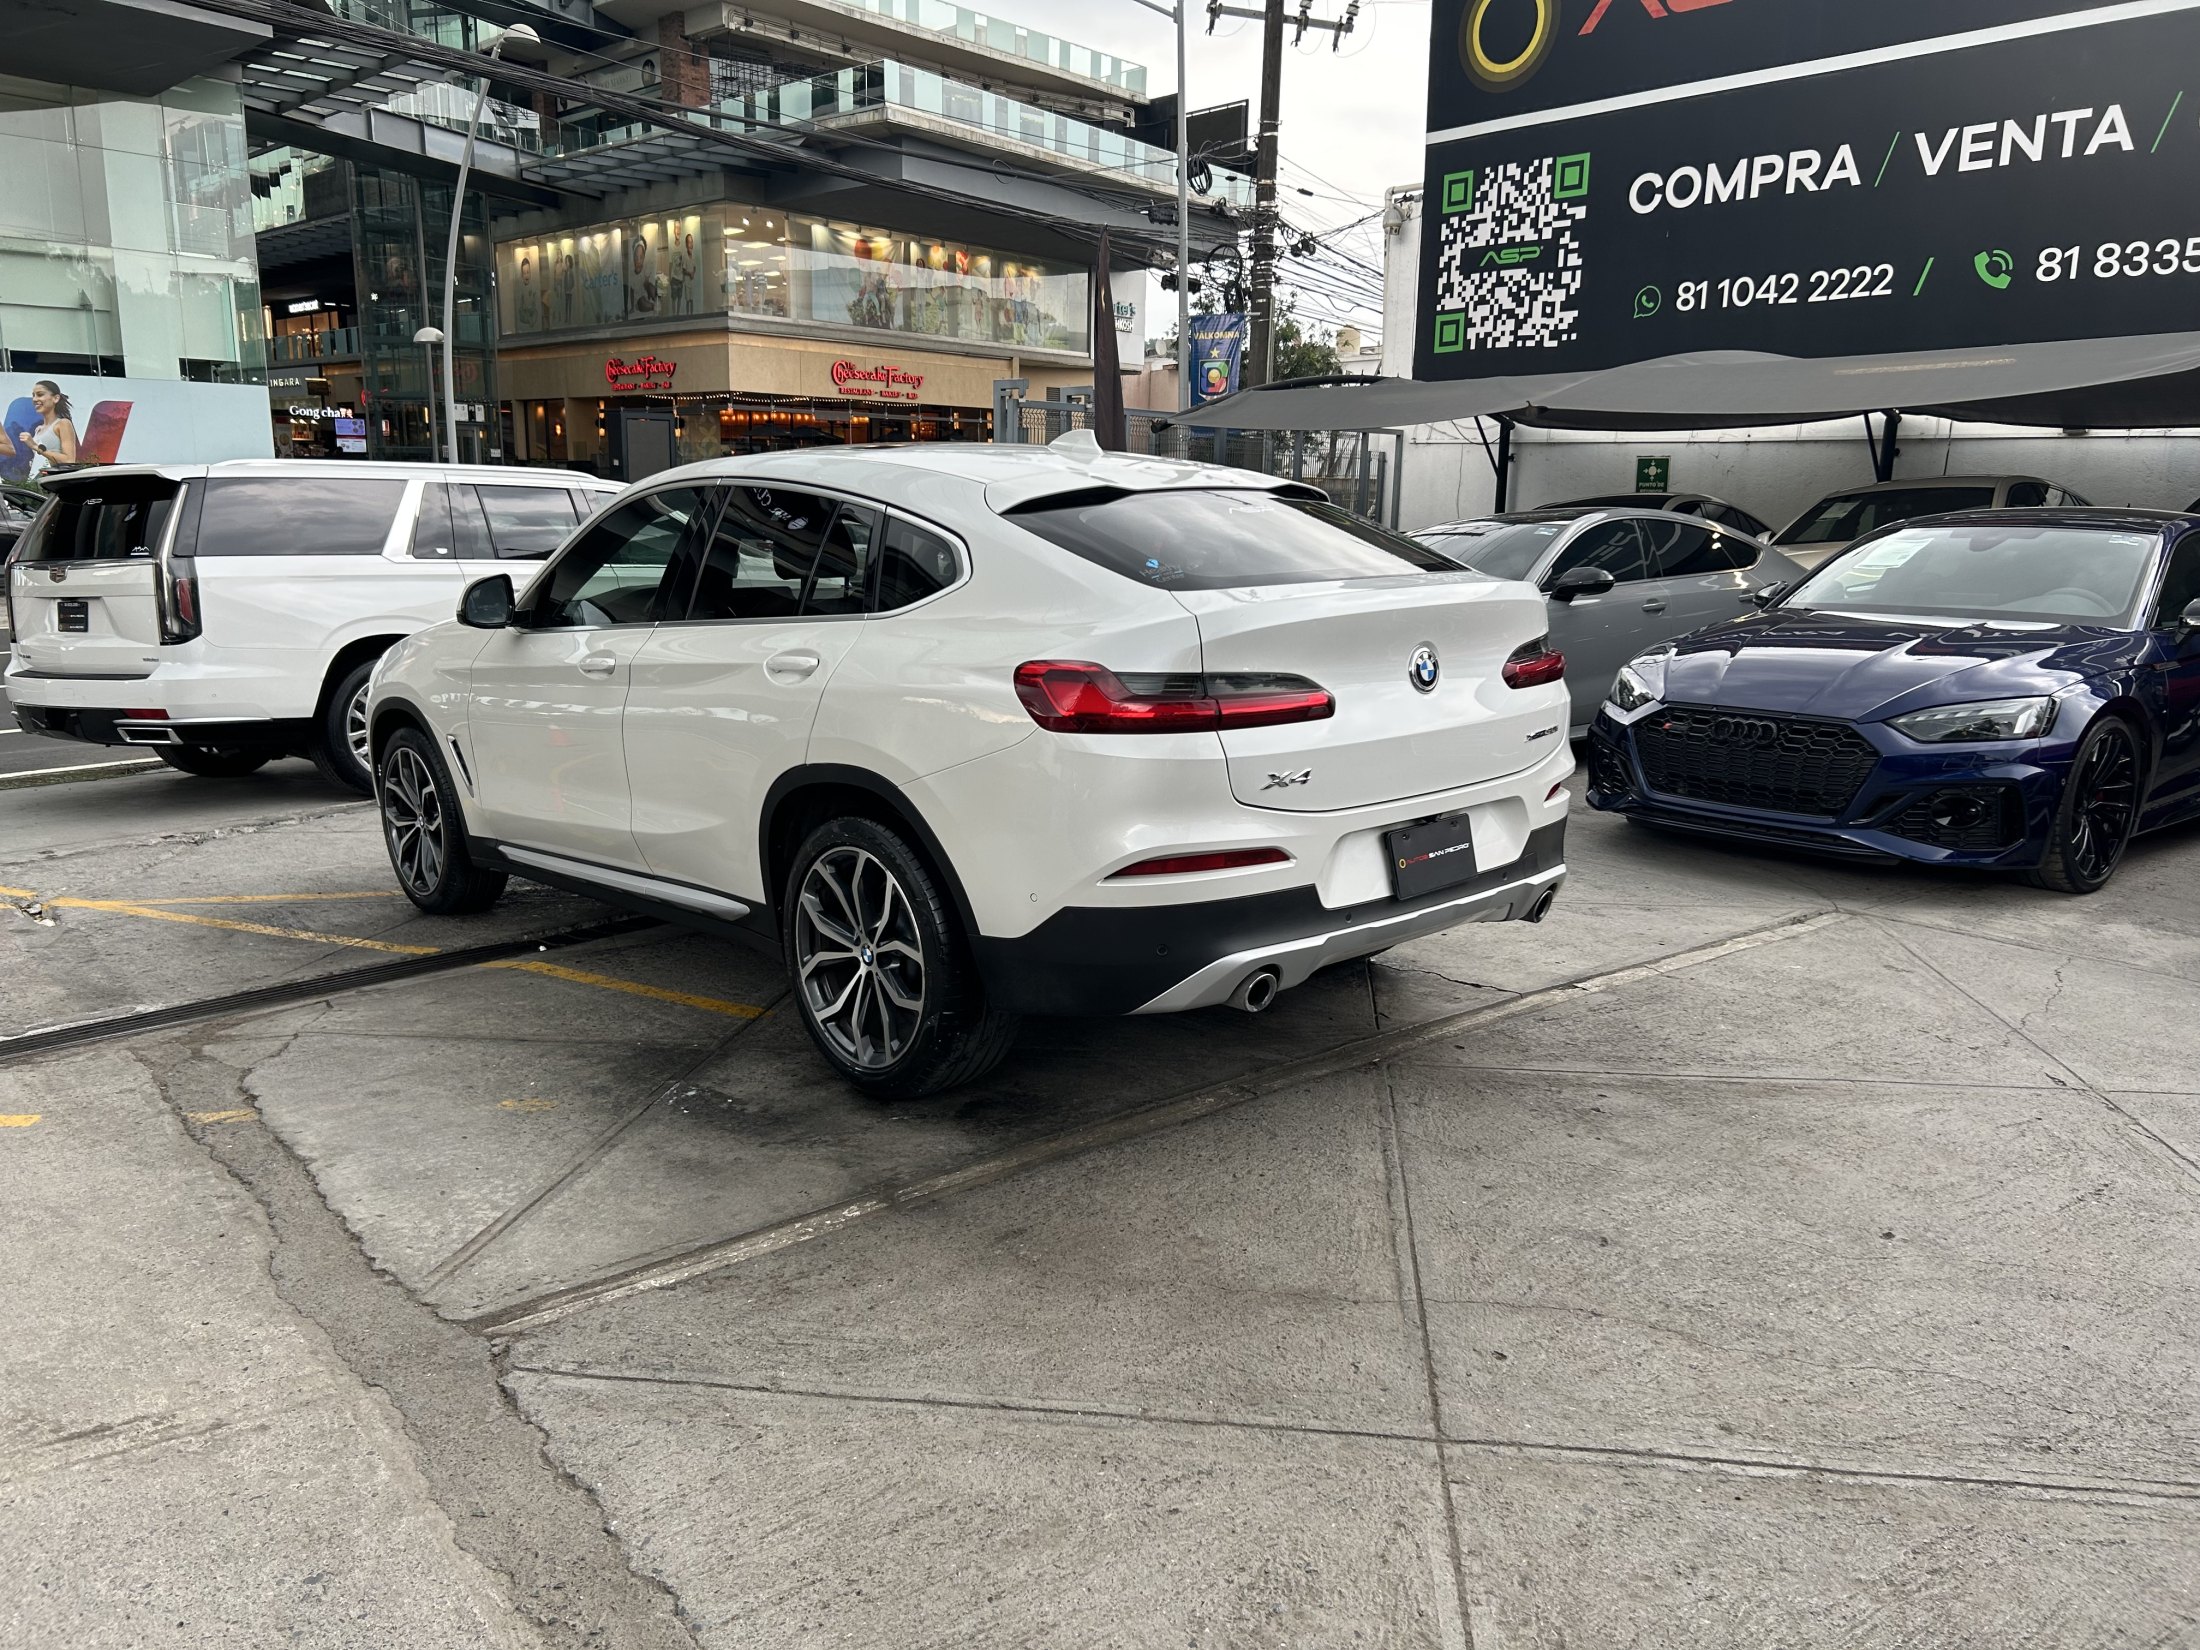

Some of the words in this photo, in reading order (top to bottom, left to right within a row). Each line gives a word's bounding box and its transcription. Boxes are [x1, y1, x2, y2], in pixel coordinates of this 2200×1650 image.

[1628, 143, 1862, 215] COMPRA
[1914, 103, 2135, 176] VENTA
[1480, 246, 1541, 267] ASP
[2035, 245, 2081, 282] 81
[2093, 236, 2200, 278] 8335
[1675, 280, 1709, 312] 81
[1717, 272, 1800, 309] 1042
[1807, 263, 1895, 303] 2222
[605, 359, 643, 383] Cheesecake
[641, 355, 677, 379] Factory
[831, 360, 887, 386] Cheesecake
[881, 365, 925, 389] Factory
[289, 405, 321, 420] Gong
[320, 406, 341, 418] cha
[1260, 767, 1312, 791] X4
[1428, 850, 1444, 858] SAN
